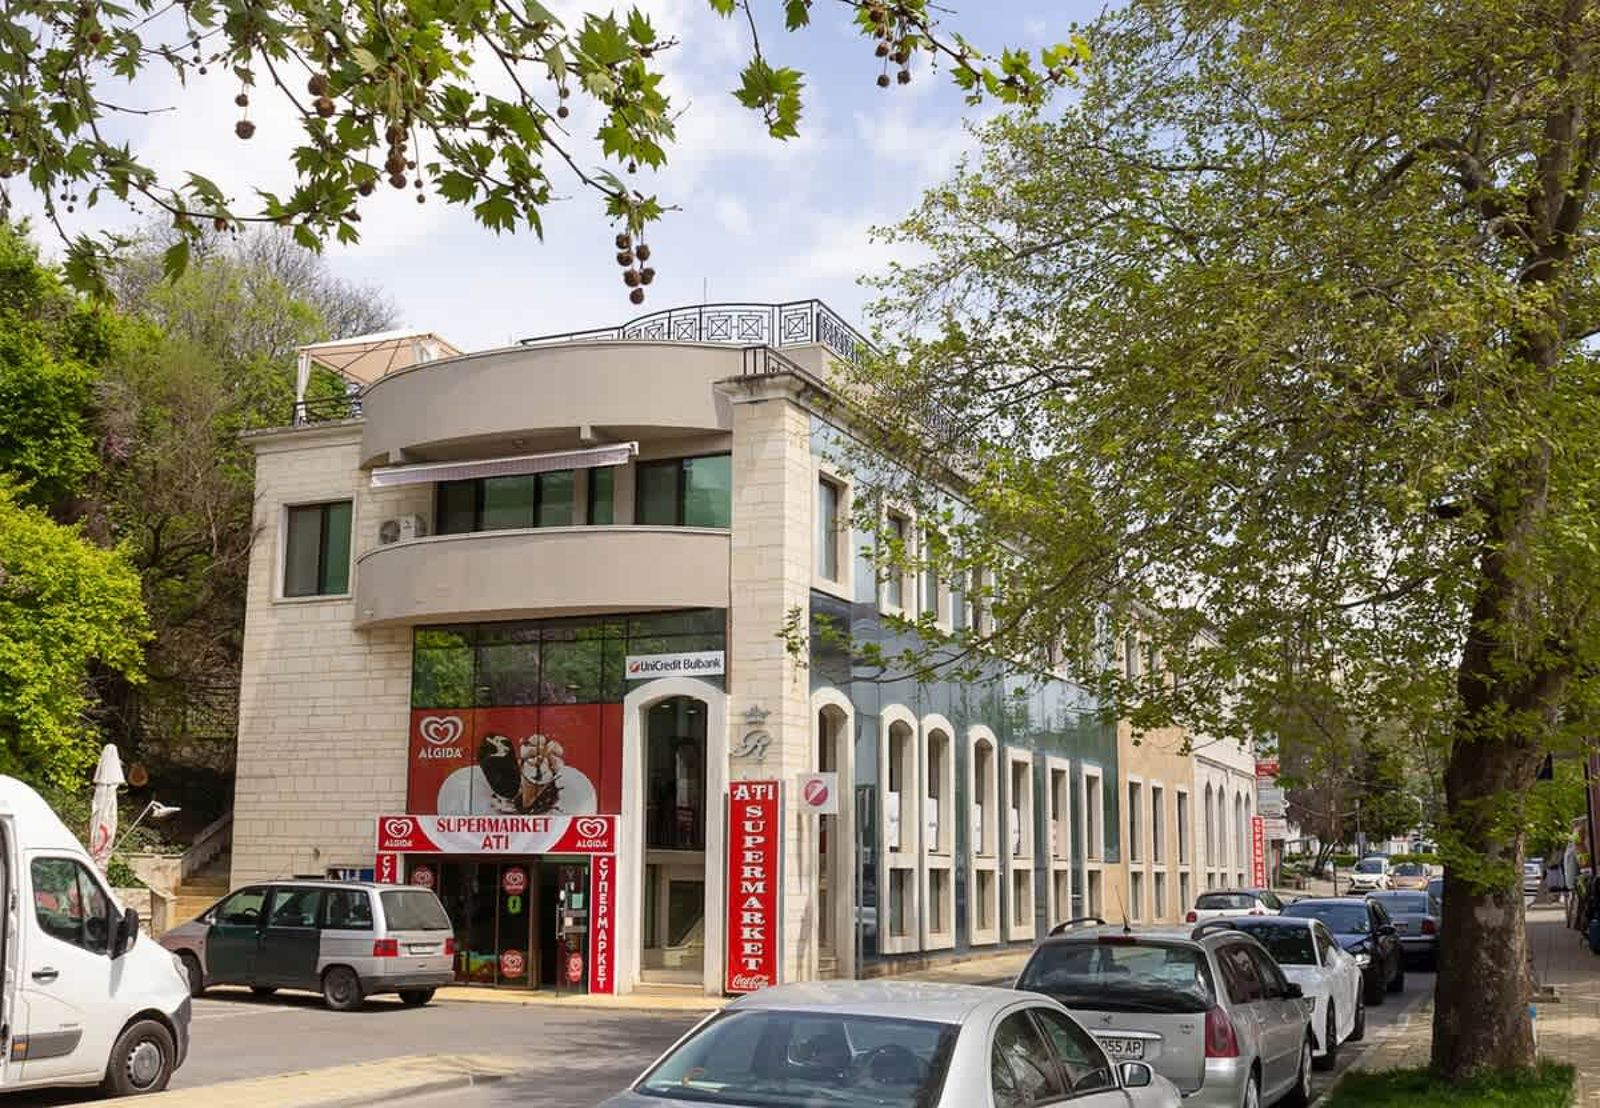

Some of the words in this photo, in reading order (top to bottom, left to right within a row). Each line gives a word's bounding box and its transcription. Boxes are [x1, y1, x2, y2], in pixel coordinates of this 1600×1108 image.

[640, 660, 682, 674] UniCredit
[684, 657, 722, 672] Bulbank
[418, 746, 464, 759] ALGIDA
[733, 784, 775, 802] ATI
[436, 817, 553, 833] SUPERMARKET
[383, 839, 413, 847] ALGIDA
[481, 834, 510, 850] ATI
[575, 839, 608, 848] ALGIDA
[741, 805, 768, 972] SUPERMARKET
[597, 858, 610, 988] СУПЕРМАРКЕТ
